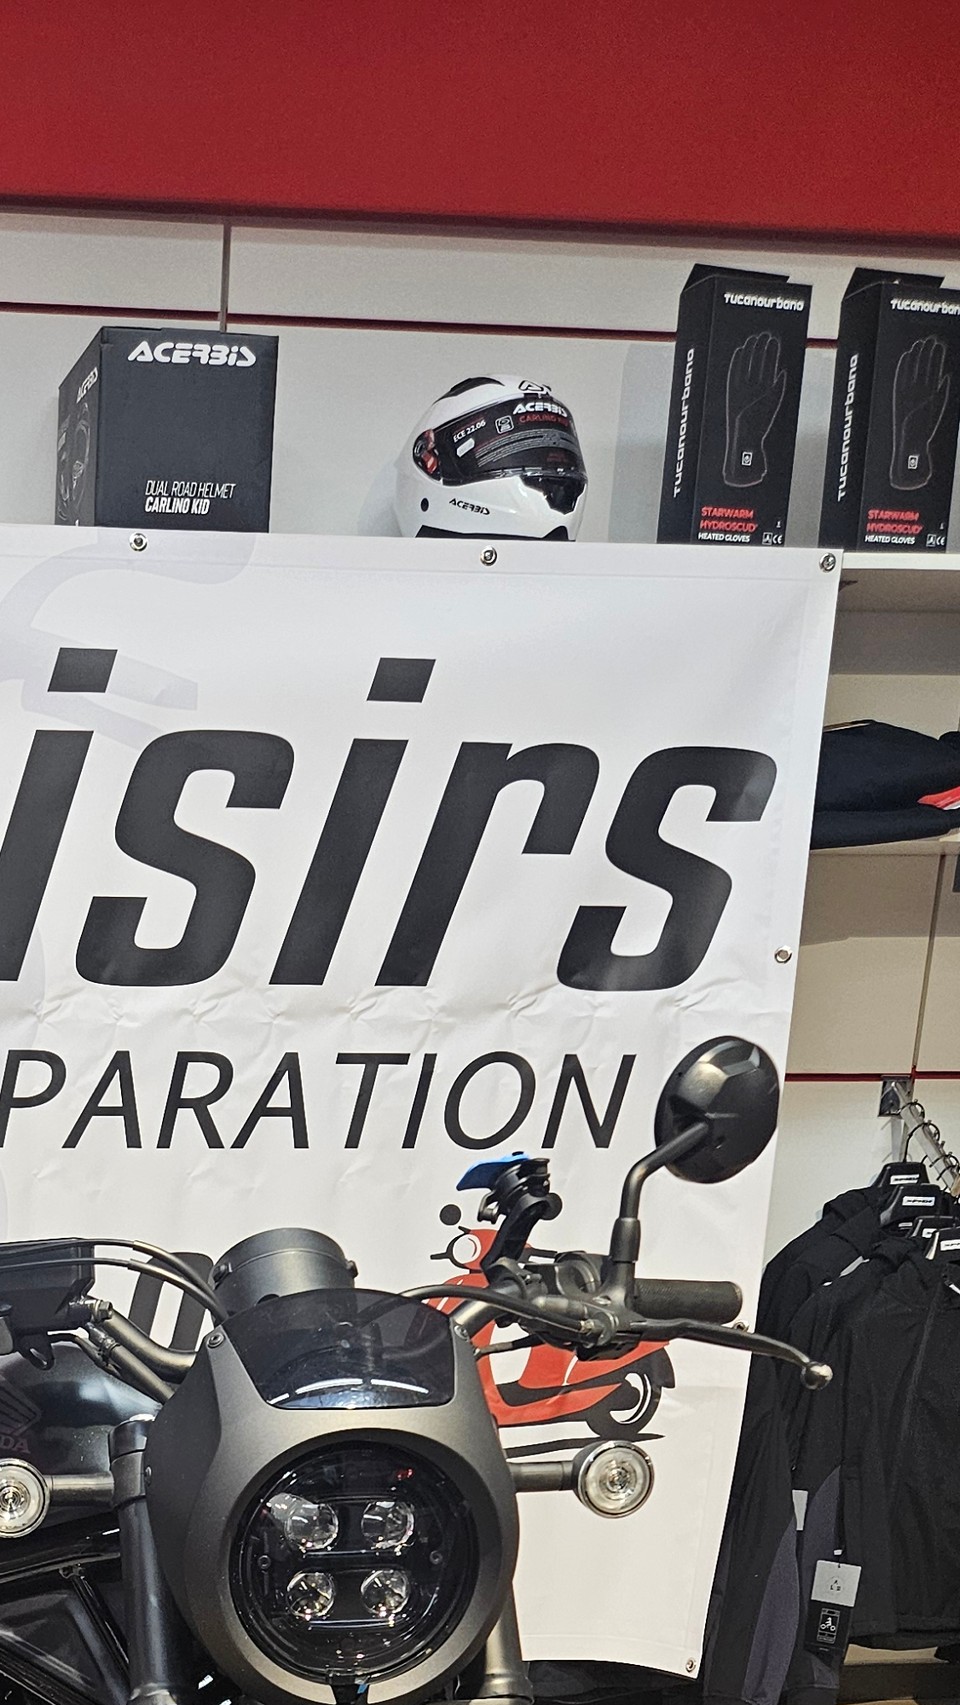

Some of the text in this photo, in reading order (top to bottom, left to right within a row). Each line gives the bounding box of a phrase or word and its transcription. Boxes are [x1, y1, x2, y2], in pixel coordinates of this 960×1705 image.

[127, 340, 257, 367] ACERBIS
[512, 402, 568, 418] ACERBIS
[465, 419, 487, 434] 22.06
[145, 480, 237, 499] DUAL ROAD HELMET
[144, 497, 211, 515] CARLINO KID
[448, 498, 491, 516] ACERBIS
[701, 506, 755, 519] STARWARM
[698, 531, 751, 544] HEATED GLOVES
[865, 534, 916, 546] HEATED GLOVES
